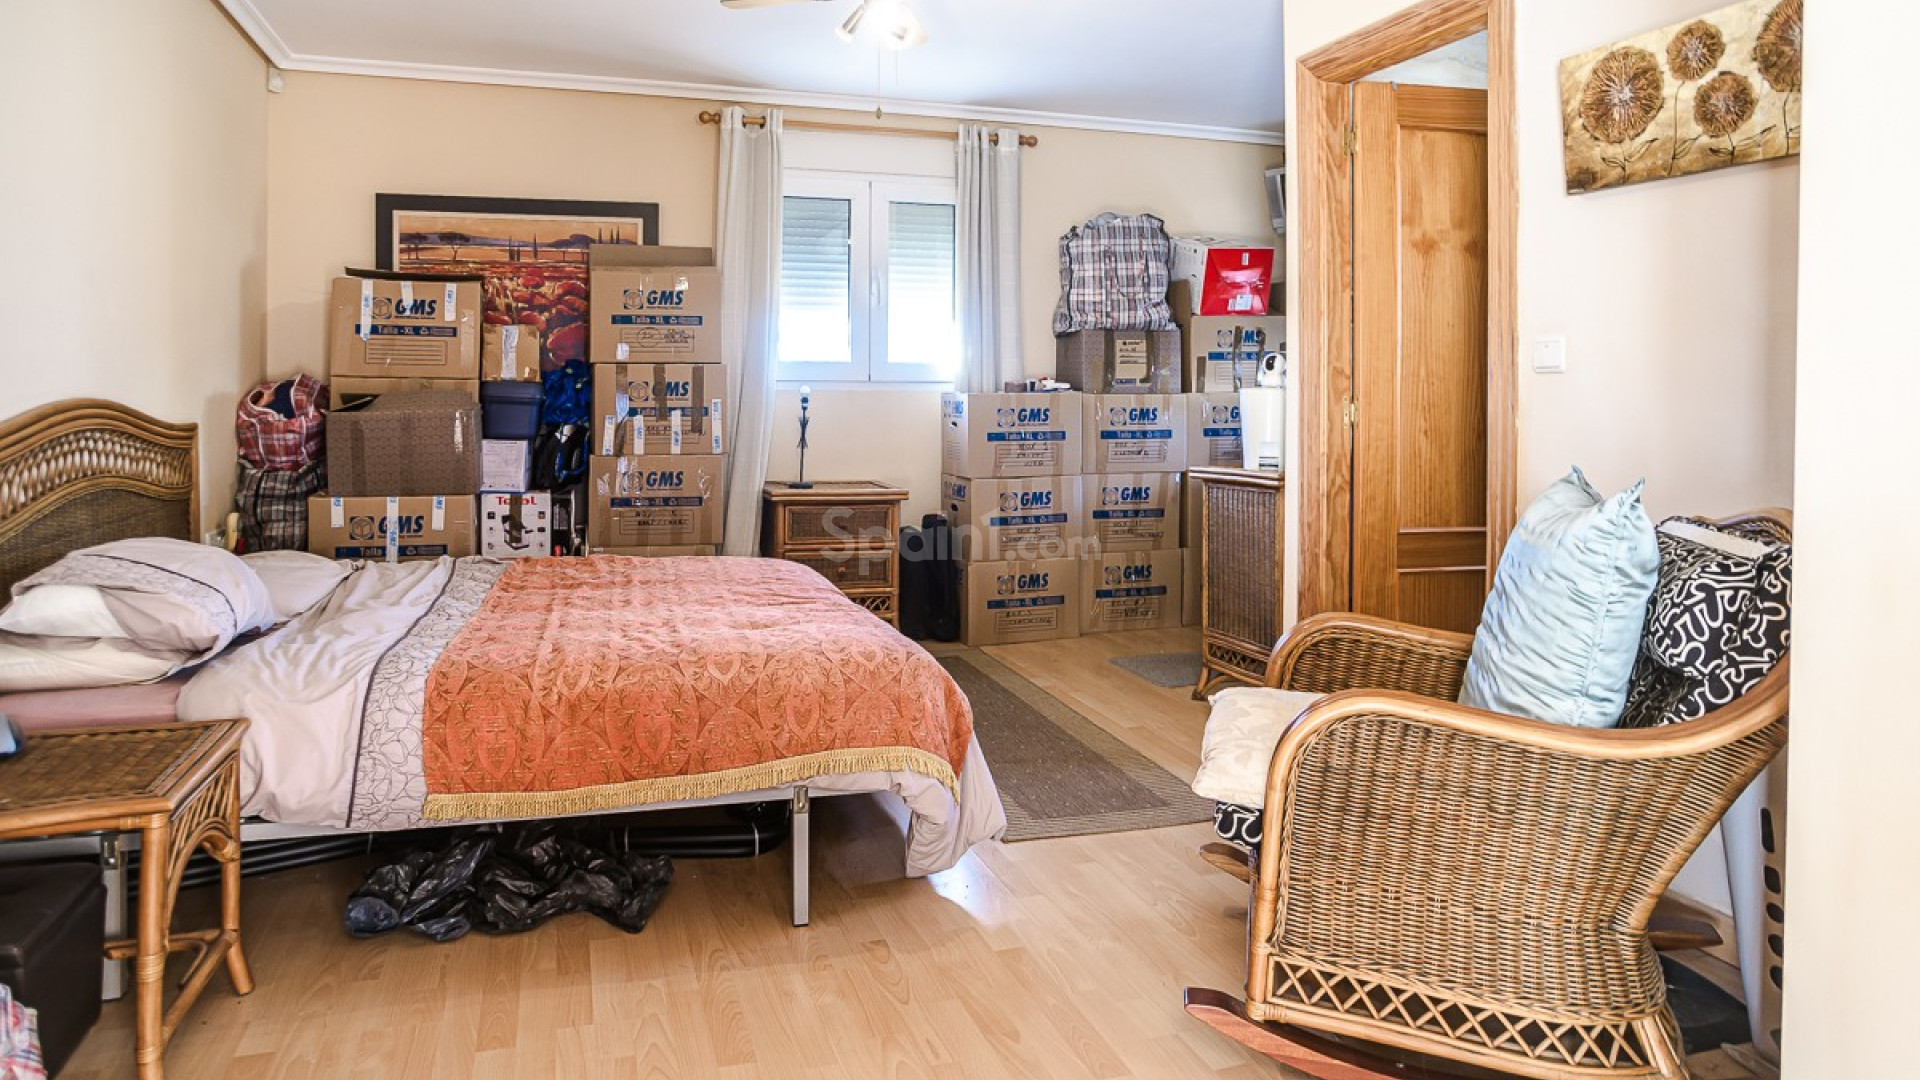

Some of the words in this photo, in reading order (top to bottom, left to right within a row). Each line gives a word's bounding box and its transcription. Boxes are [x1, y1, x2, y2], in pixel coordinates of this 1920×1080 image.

[646, 290, 684, 306] GMS
[652, 381, 690, 397] MS
[1017, 408, 1050, 423] GMS
[1129, 406, 1158, 422] GMS
[646, 471, 683, 488] GMS
[1020, 491, 1052, 507] GMS
[1121, 487, 1151, 501] GMS
[1123, 564, 1152, 580] GMS
[1017, 572, 1049, 589] GMS
